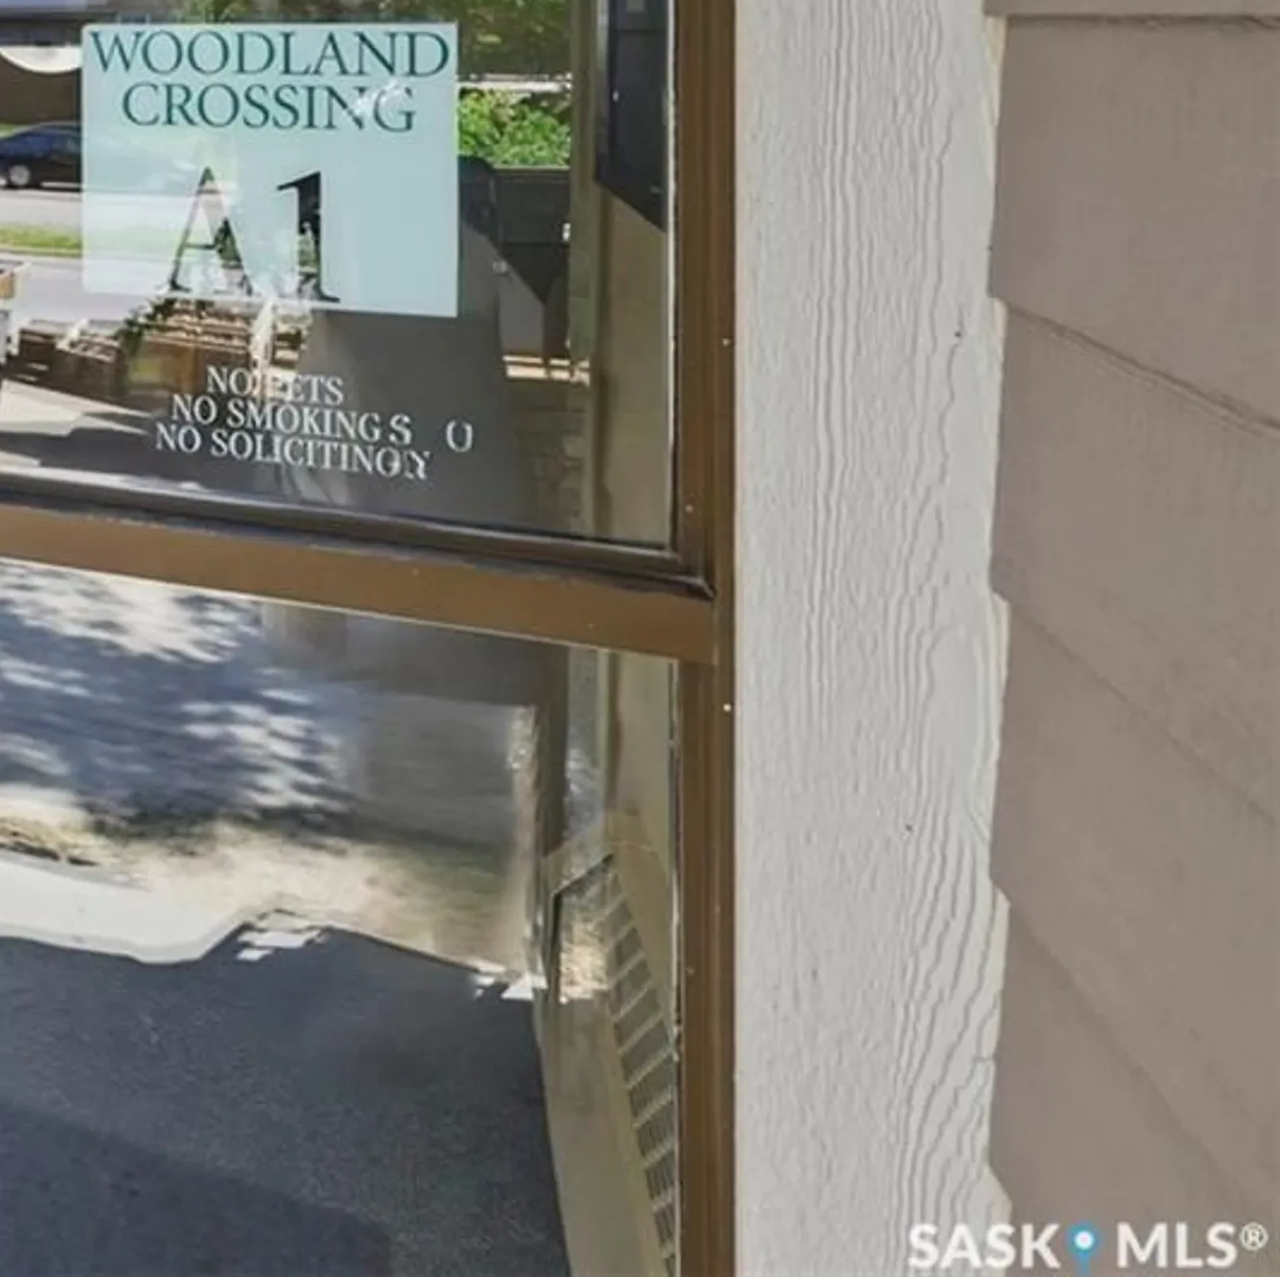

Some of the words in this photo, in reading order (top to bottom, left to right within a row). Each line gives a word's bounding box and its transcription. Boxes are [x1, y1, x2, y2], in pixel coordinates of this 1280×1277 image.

[89, 29, 450, 79] WOODLAND
[121, 82, 418, 133] CROSSING
[206, 364, 251, 397] NO
[155, 421, 202, 454] NO
[171, 393, 218, 425] NO
[225, 397, 382, 443] SMOKING
